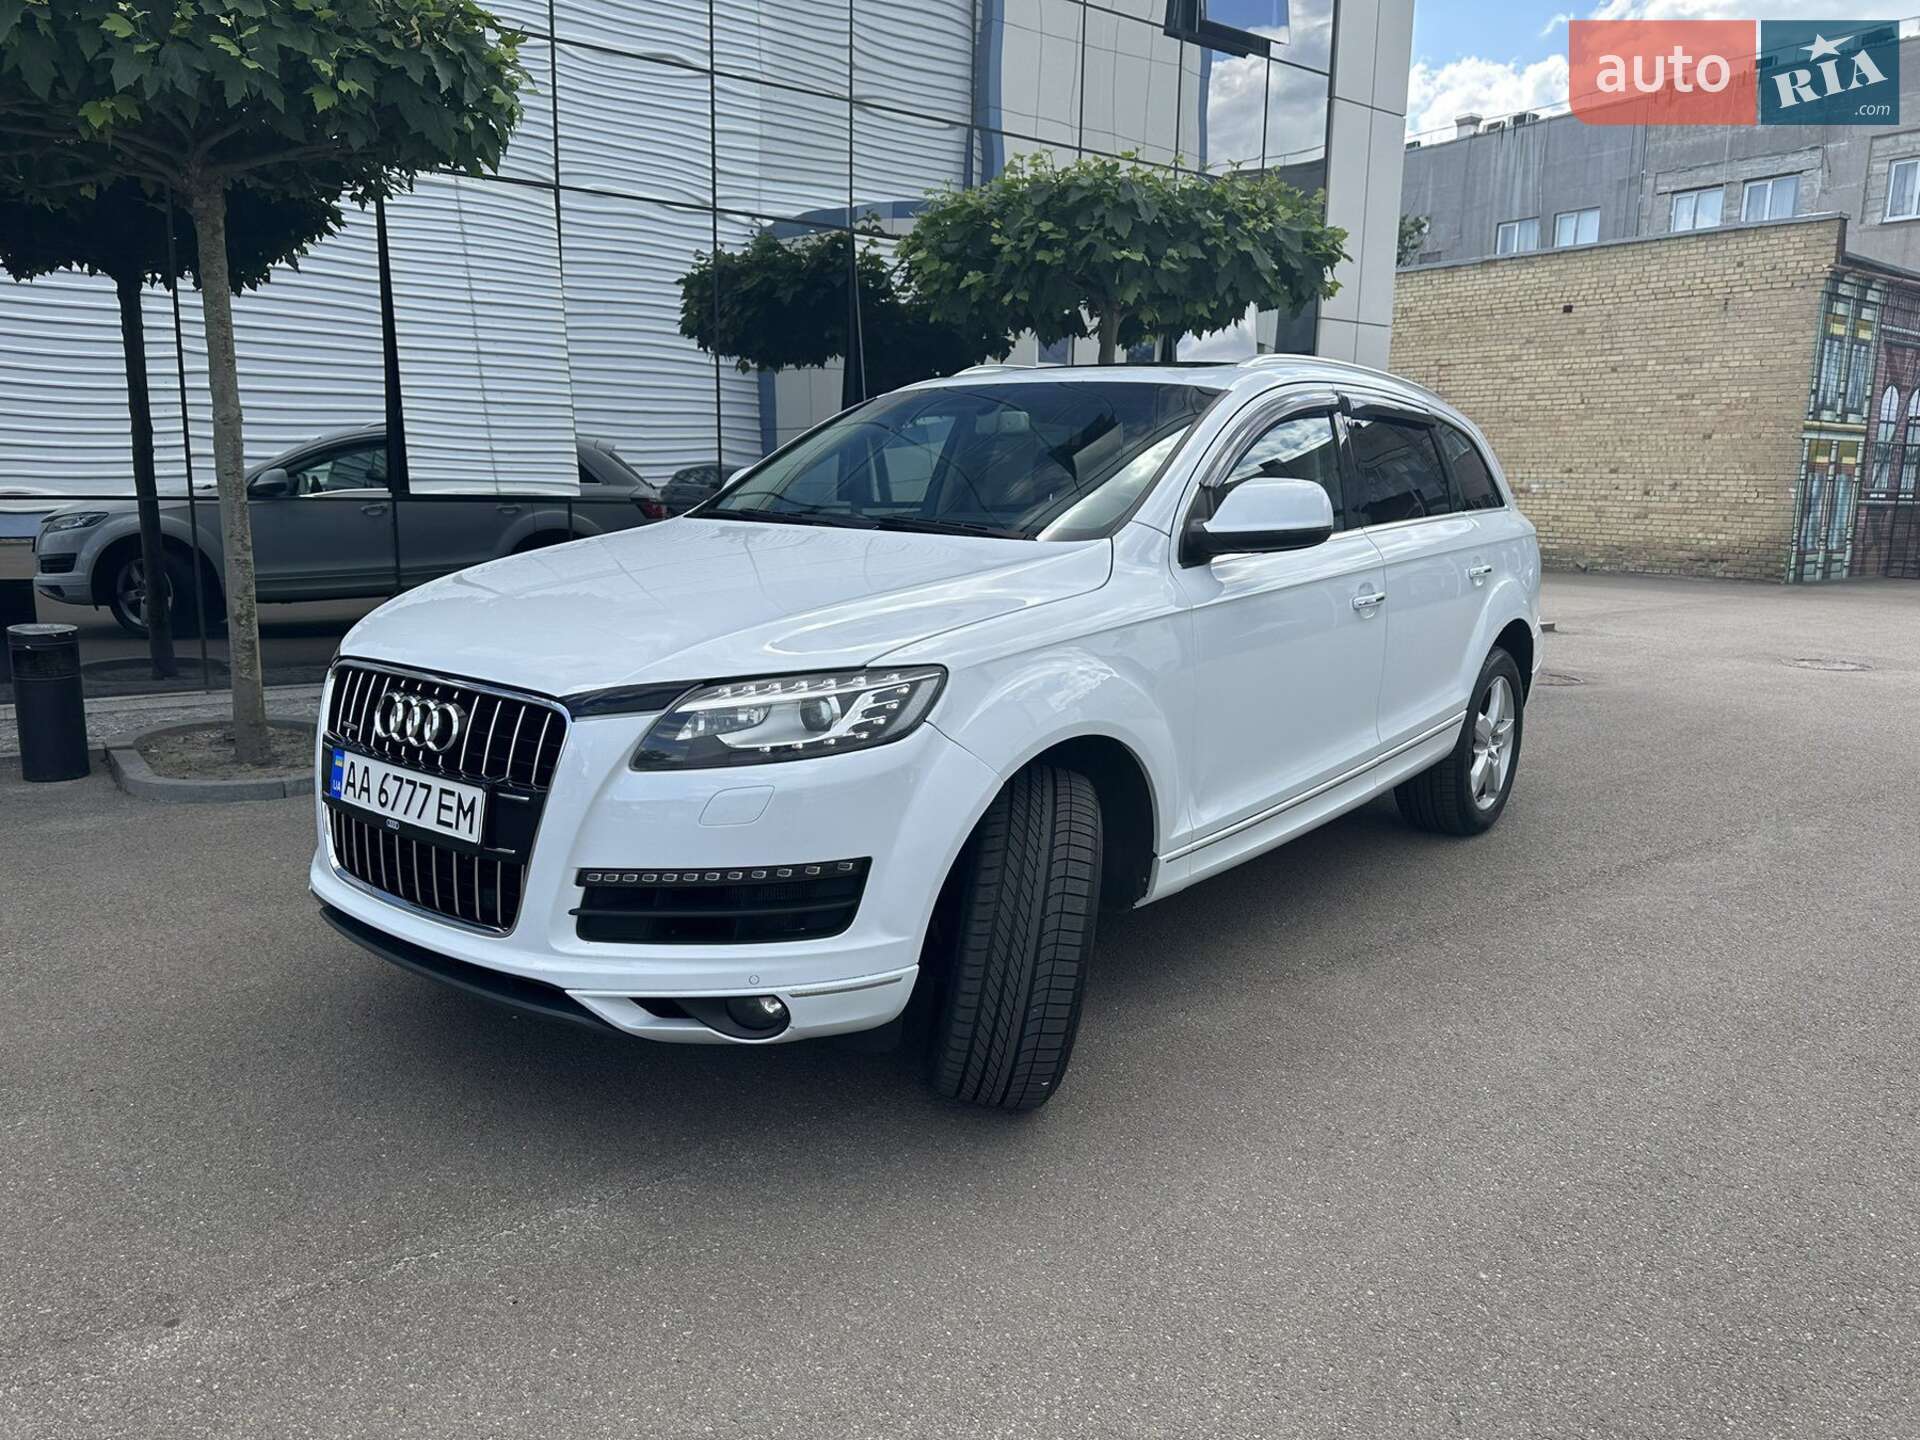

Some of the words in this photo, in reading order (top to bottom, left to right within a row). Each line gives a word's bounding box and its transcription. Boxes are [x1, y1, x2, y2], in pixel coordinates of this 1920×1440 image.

[344, 761, 371, 803] AA
[378, 773, 432, 819] 6777
[436, 788, 477, 834] EM
